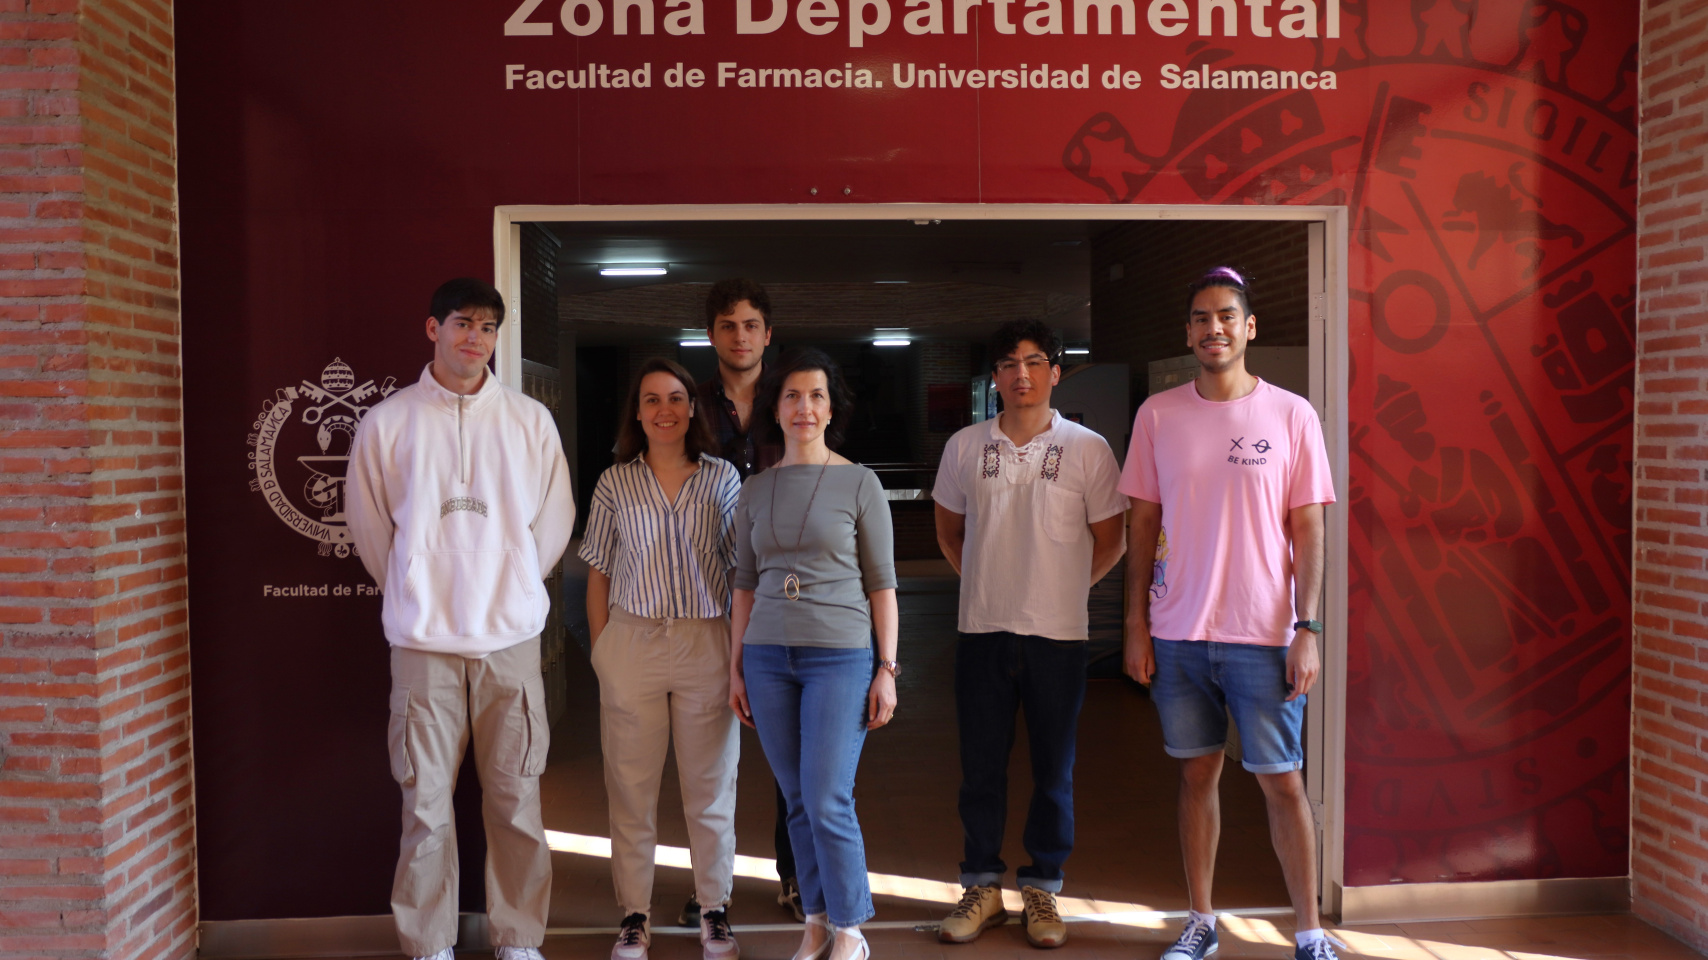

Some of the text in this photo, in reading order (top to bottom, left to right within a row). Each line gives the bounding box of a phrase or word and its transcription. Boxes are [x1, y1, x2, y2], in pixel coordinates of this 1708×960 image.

[505, 0, 1339, 48] Zona Departamental
[506, 62, 1337, 89] Facultad de Farmacia. Universidad de Salamanca
[260, 406, 290, 478] SALAMANCA
[1227, 455, 1267, 466] BE KIND
[263, 583, 379, 597] Facultad de Far
